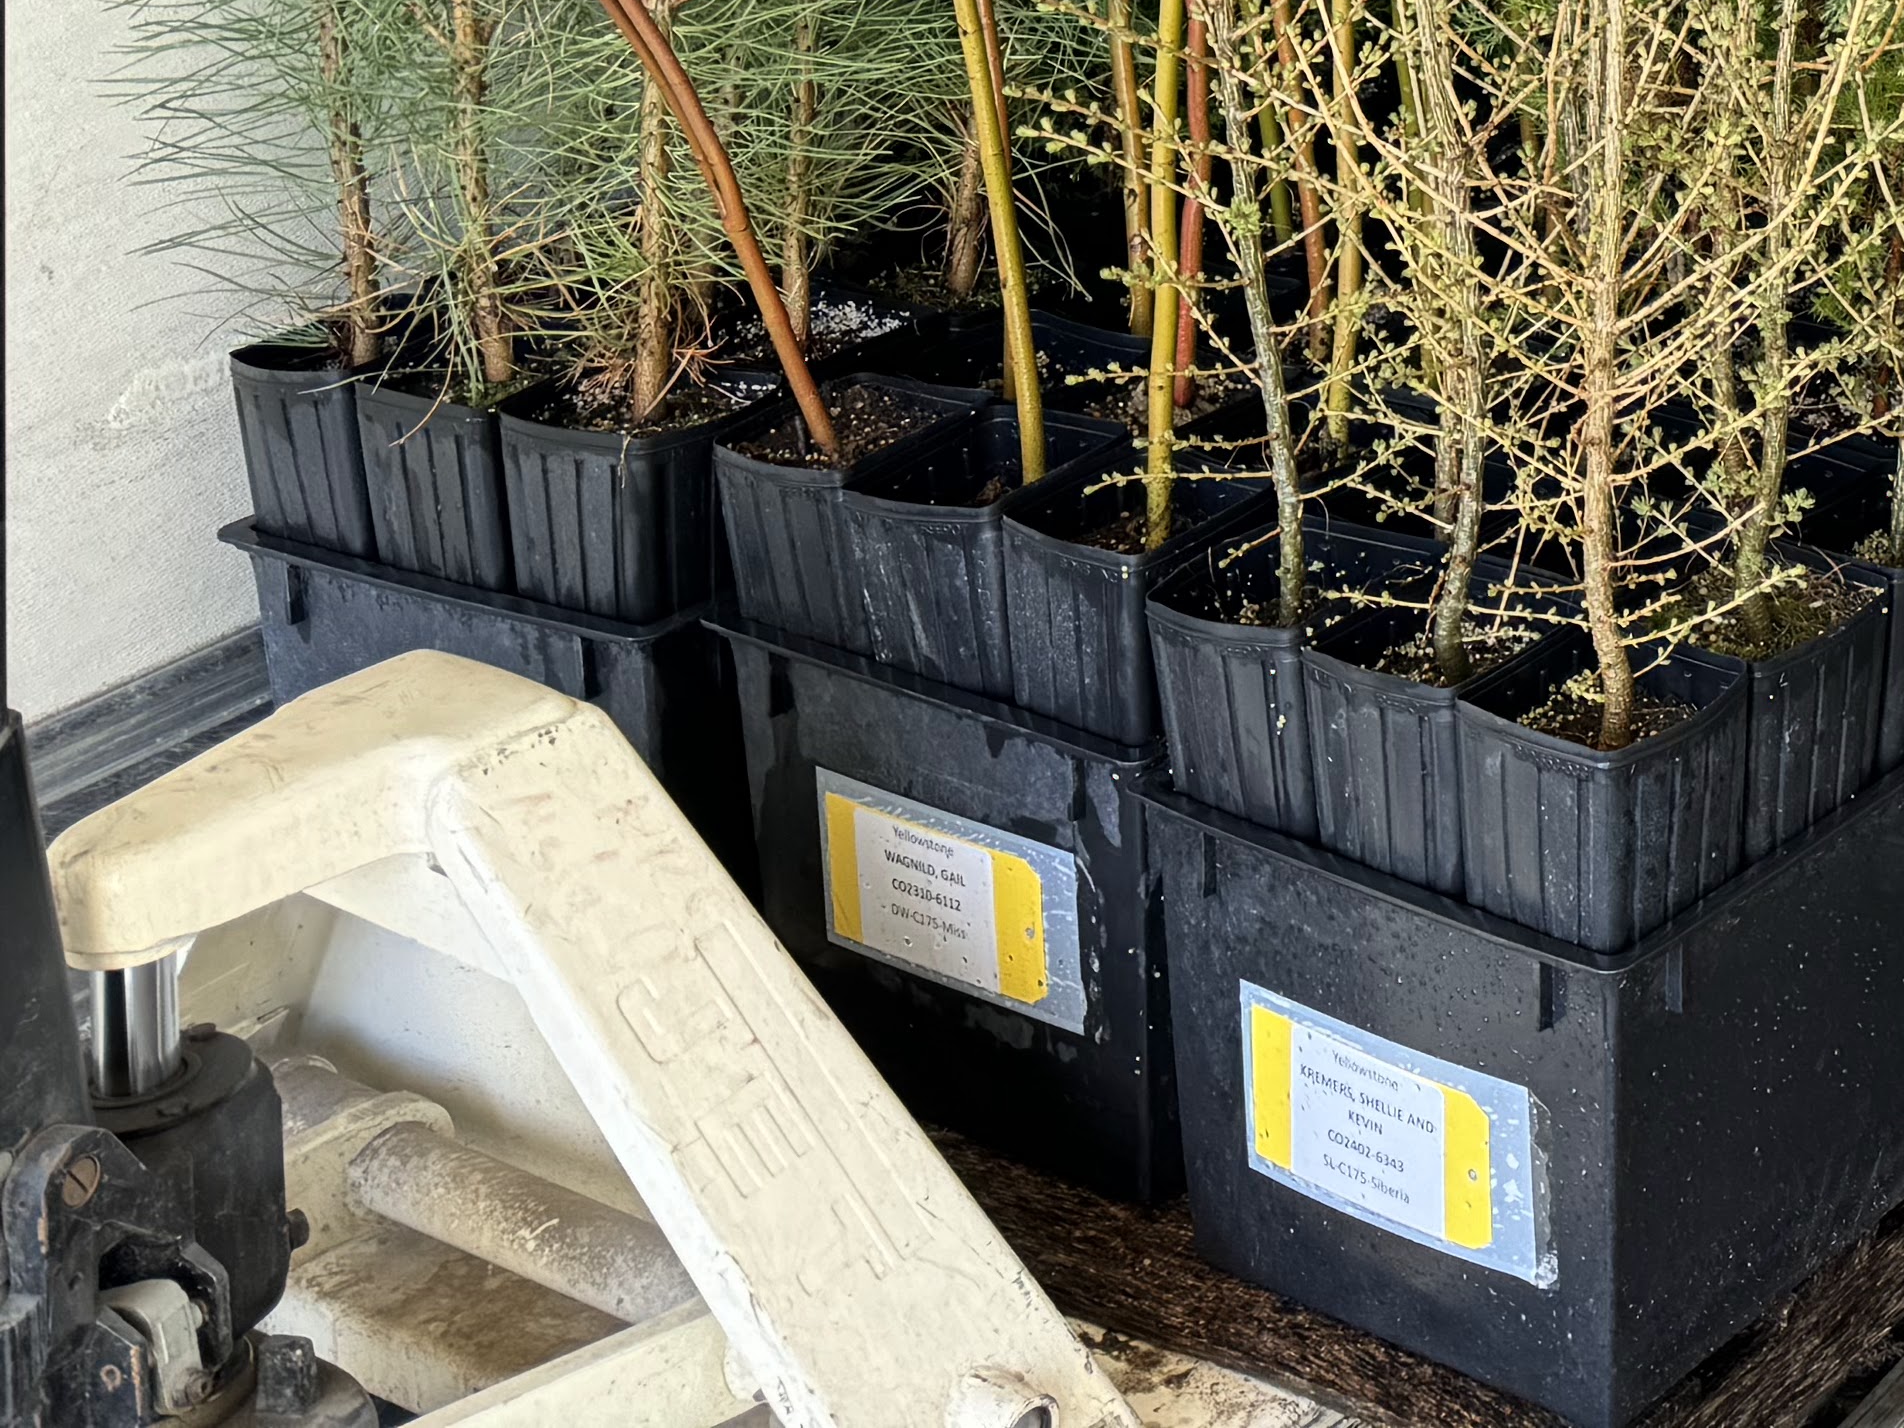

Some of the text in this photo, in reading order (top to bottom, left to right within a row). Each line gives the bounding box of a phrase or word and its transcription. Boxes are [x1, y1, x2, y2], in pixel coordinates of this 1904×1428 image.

[892, 824, 955, 857] Yellowstone
[884, 848, 966, 887] WAGNILD, GAIL
[891, 878, 962, 912] CO2310-6112
[1299, 1064, 1435, 1135] KREMERS, SHELLIE AND
[1348, 1110, 1383, 1136] KEVIN
